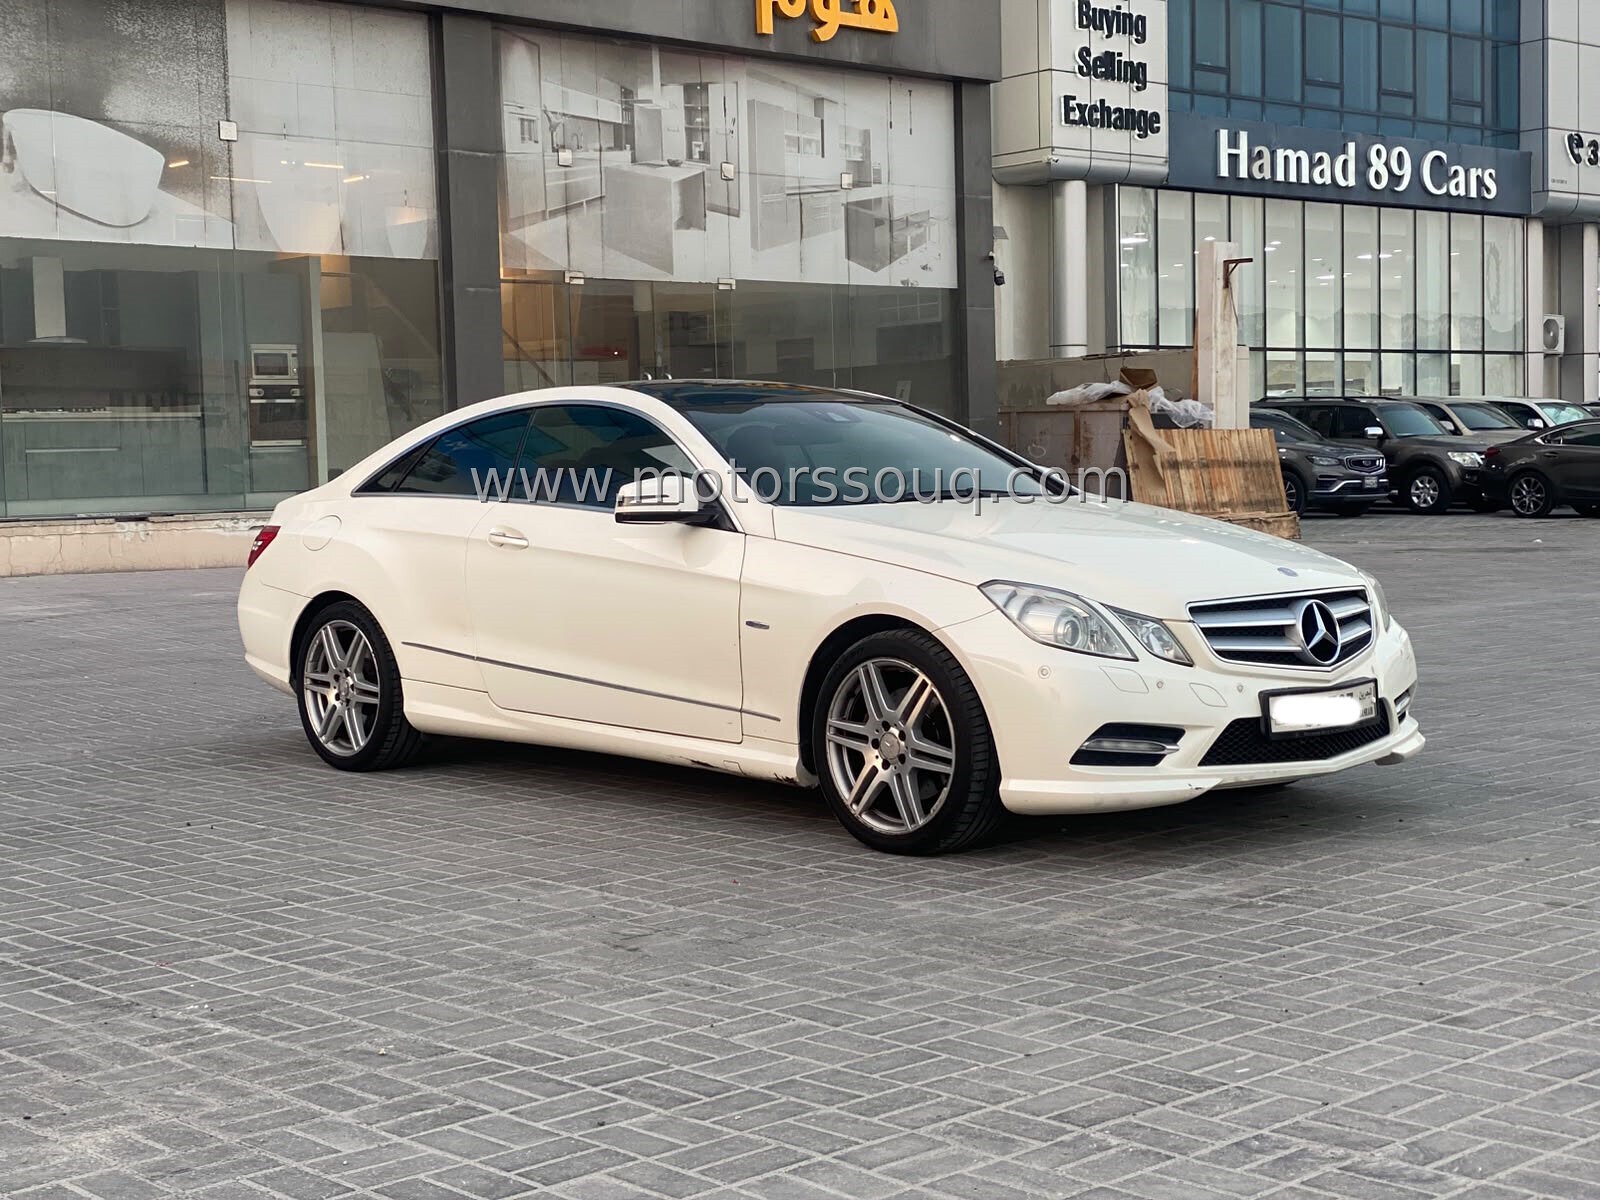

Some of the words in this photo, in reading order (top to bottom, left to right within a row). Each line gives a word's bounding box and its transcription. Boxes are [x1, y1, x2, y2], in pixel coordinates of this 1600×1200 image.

[1076, 0, 1147, 45] Buying
[1076, 46, 1148, 92] Selling
[1062, 94, 1161, 139] Exchange
[1216, 128, 1356, 188] Hamad
[1366, 143, 1412, 192] 89
[1420, 150, 1498, 200] Cars
